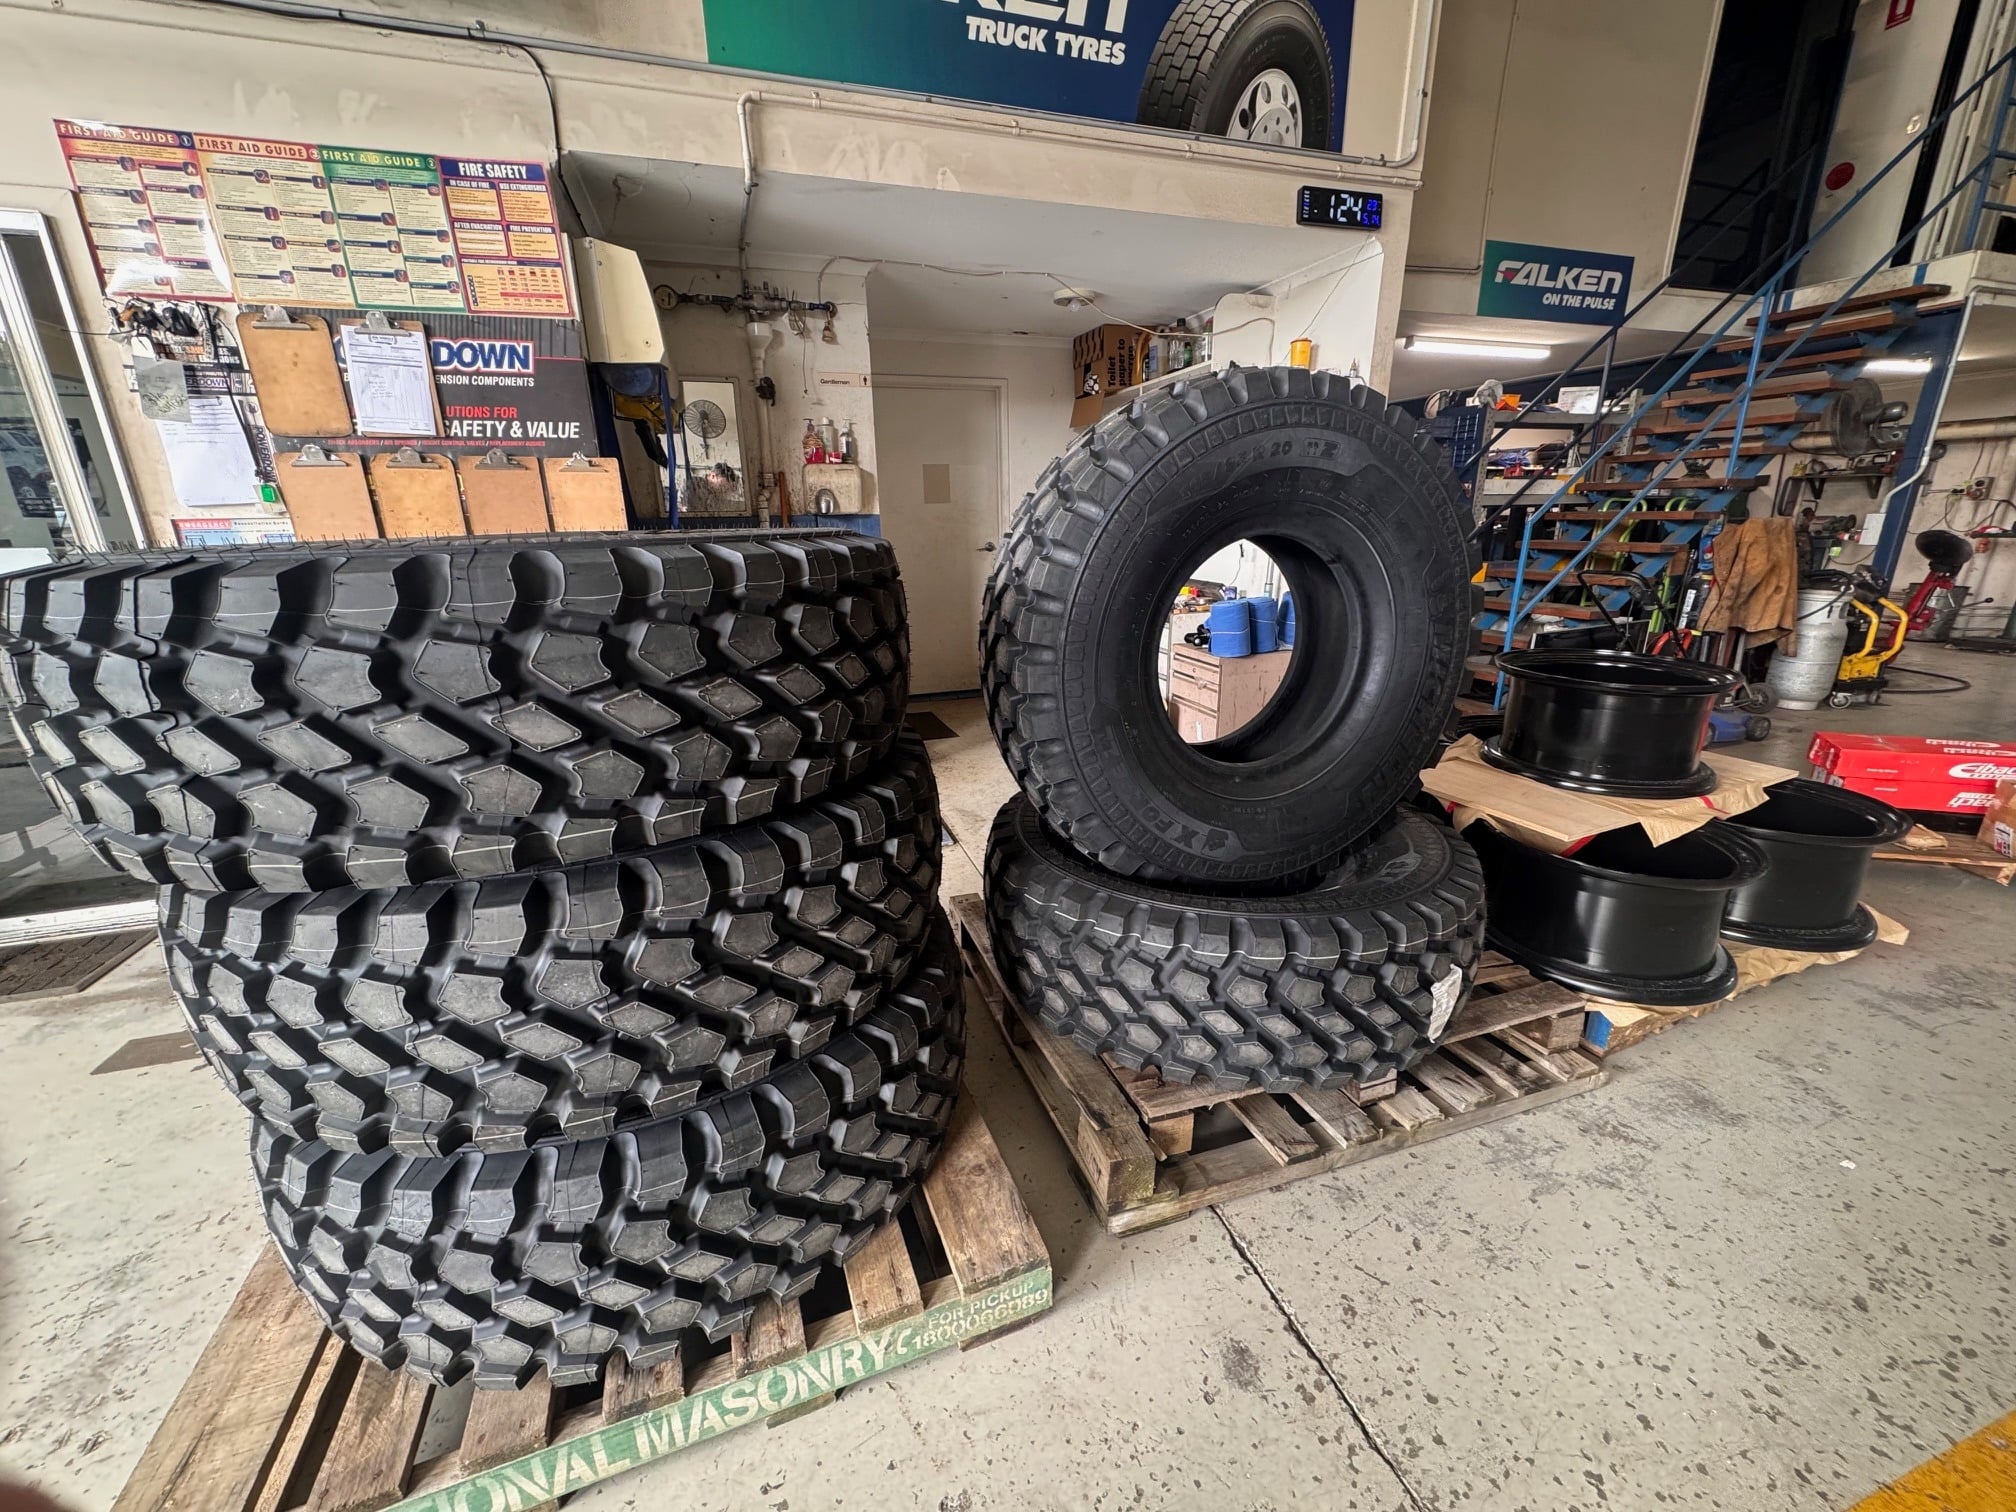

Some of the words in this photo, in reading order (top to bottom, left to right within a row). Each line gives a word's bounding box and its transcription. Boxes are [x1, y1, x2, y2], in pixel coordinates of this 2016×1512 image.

[966, 15, 1048, 52] TRUCK
[1055, 31, 1126, 66] TYRES
[59, 123, 97, 136] FIRST
[104, 126, 126, 138] AID
[132, 130, 175, 144] GUIDE
[199, 138, 233, 151] FIRST
[238, 142, 260, 154] AID
[265, 145, 304, 158] GUIDE
[322, 150, 356, 162] FIRST
[359, 153, 380, 164] AID
[385, 155, 421, 167] GUIDE
[458, 162, 485, 178] FIRE
[485, 163, 527, 179] SAFETY
[1542, 293, 1561, 306] ON
[1562, 295, 1582, 308] THE
[1582, 296, 1616, 310] PULSE
[1117, 338, 1126, 350] to
[1107, 356, 1116, 387] Toilet
[1119, 352, 1127, 386] paper
[471, 376, 535, 387] COMPONENTS
[493, 407, 518, 418] FOR
[510, 420, 523, 437] &
[527, 421, 580, 438] VALUE
[928, 1307, 964, 1330] FOR
[970, 1281, 1034, 1315] PICKUP
[416, 1434, 631, 1512] ONAL
[633, 1327, 893, 1457] MASONRY
